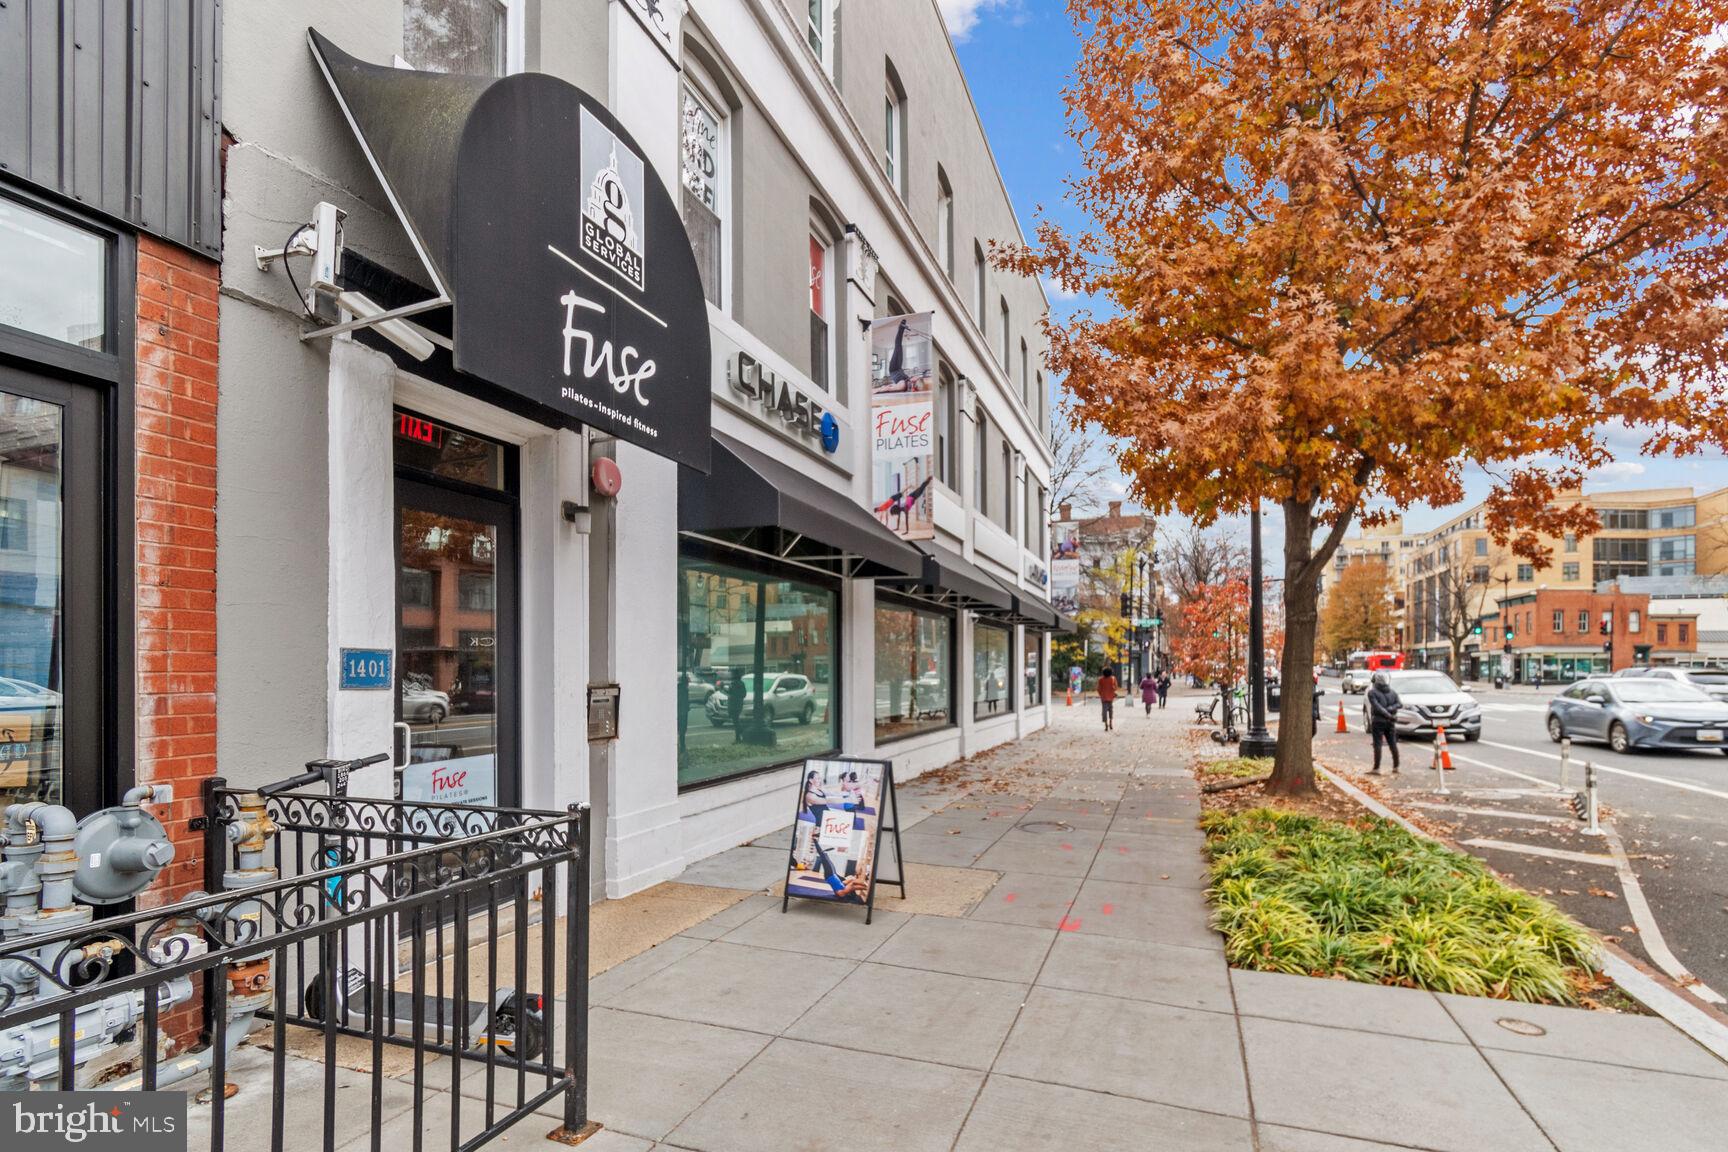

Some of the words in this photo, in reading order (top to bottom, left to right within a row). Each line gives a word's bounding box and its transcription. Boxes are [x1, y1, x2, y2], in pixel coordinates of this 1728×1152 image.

[585, 222, 641, 271] GLOBAL
[585, 236, 641, 282] SERVICES
[560, 289, 656, 406] Fuse
[730, 351, 823, 440] CHASE
[633, 418, 658, 438] fitness
[875, 410, 931, 437] Fuse
[876, 433, 929, 451] PILATES
[349, 659, 386, 678] 1401
[432, 767, 467, 794] Fuse
[825, 817, 850, 834] Fuse
